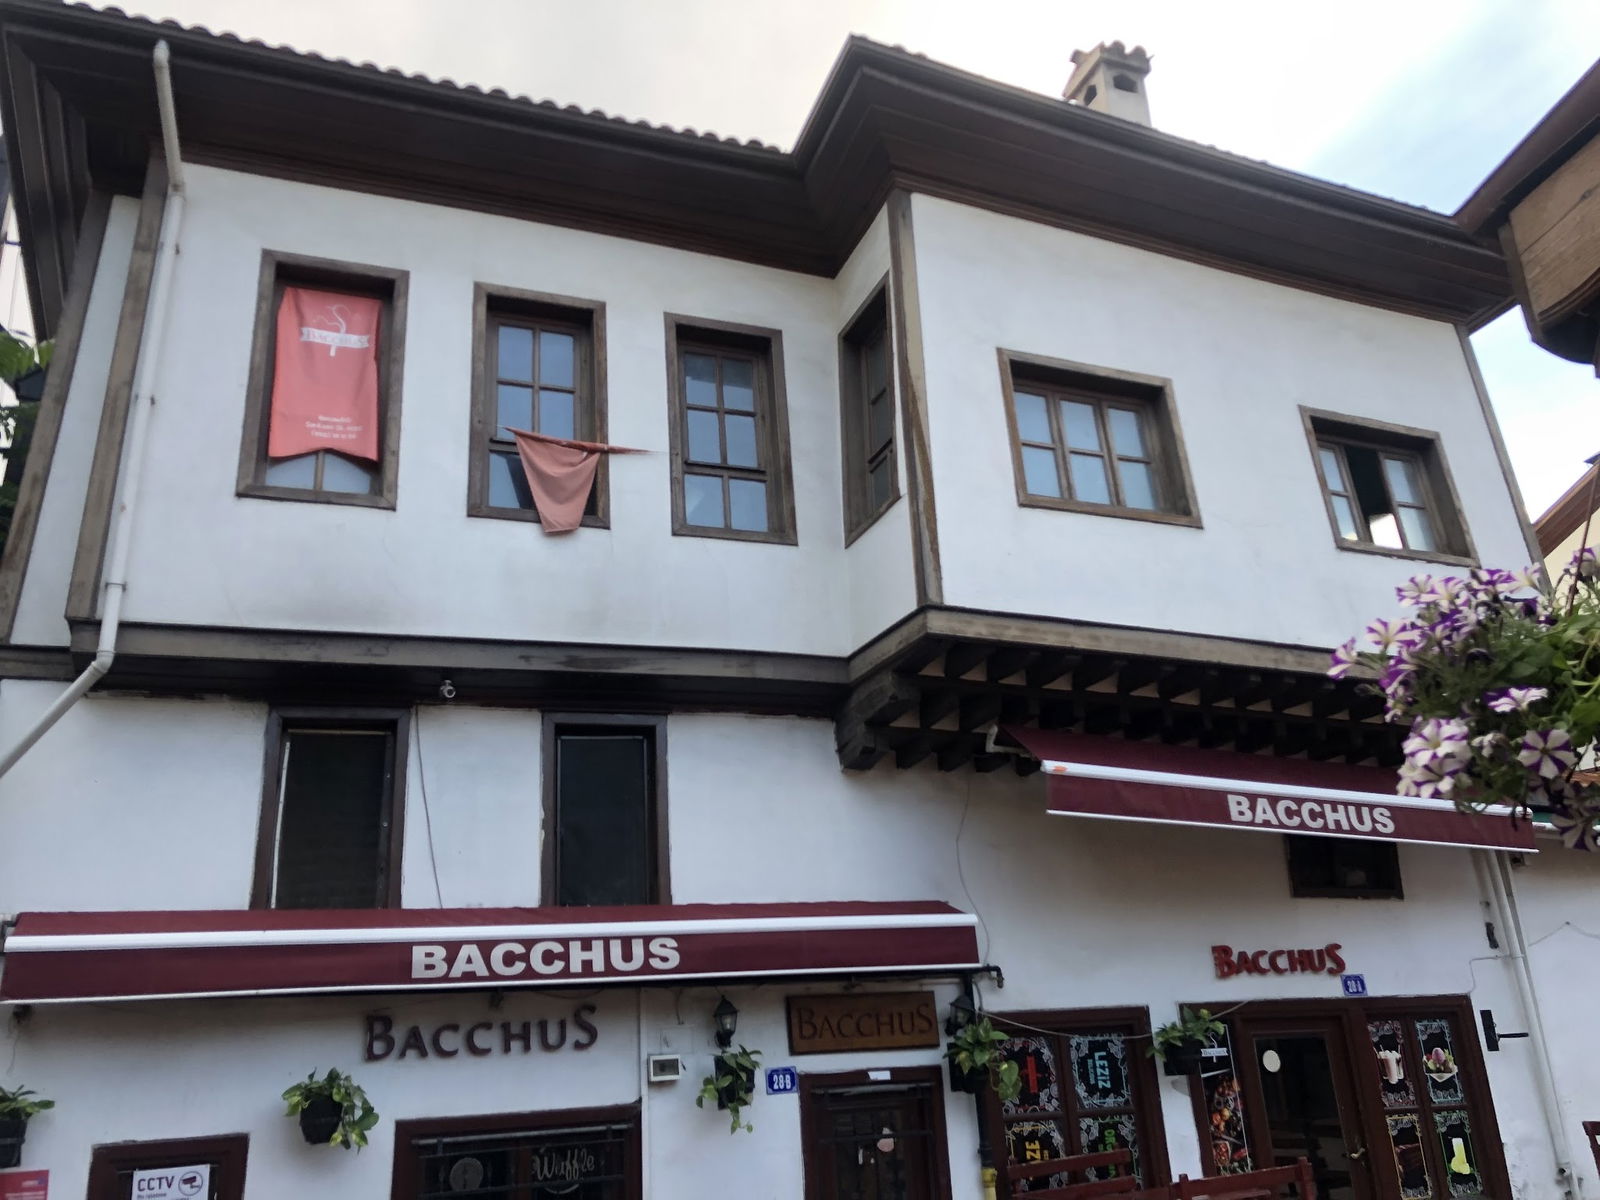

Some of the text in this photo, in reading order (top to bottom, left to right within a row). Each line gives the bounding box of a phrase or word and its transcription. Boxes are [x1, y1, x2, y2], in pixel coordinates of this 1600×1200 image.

[1228, 795, 1395, 833] BACCHUS
[411, 938, 680, 979] BACCHUS
[1212, 943, 1346, 979] BACCHUS
[366, 1004, 598, 1061] BACCHUS
[797, 1003, 934, 1040] BACCHUS
[138, 1175, 175, 1192] CCTV
